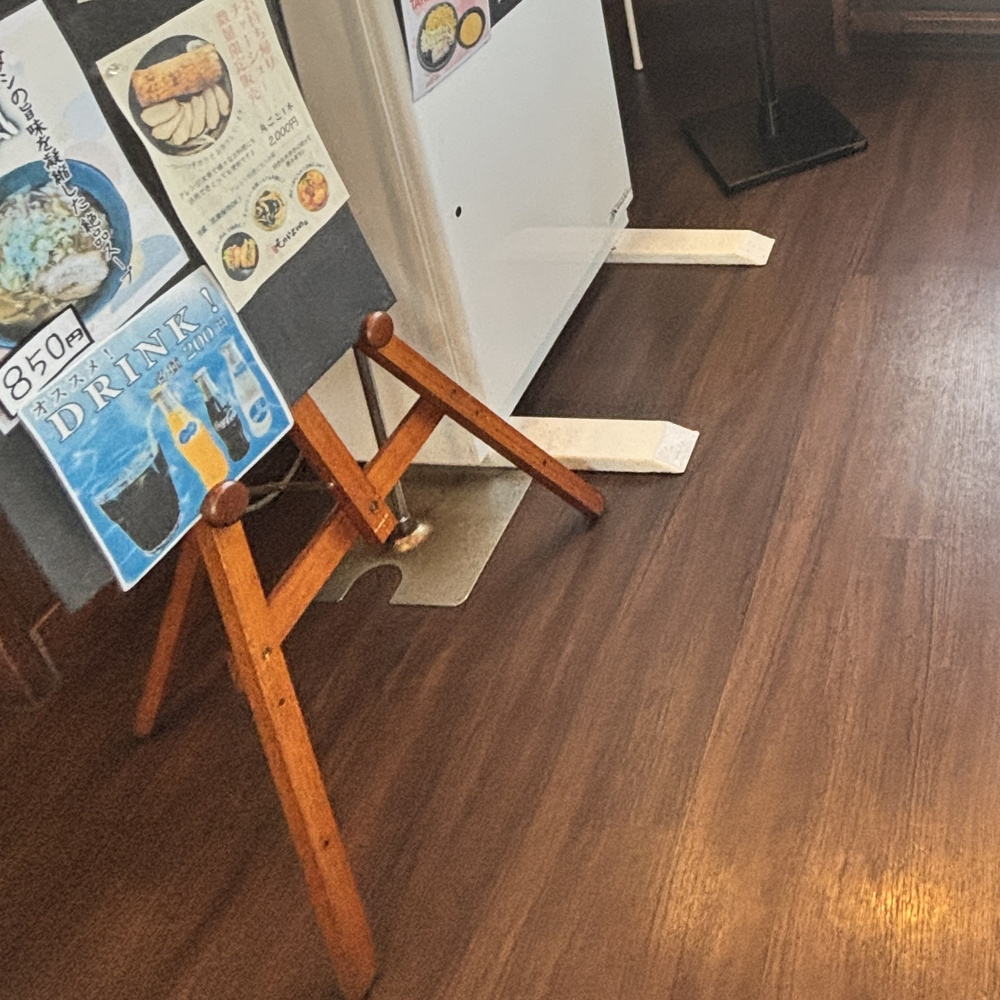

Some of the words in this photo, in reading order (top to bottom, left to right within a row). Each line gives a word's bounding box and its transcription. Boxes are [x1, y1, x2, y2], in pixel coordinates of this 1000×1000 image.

[0, 50, 132, 285] シの旨味を凝縮した絶品スープ
[3, 328, 84, 402] 850円
[182, 316, 229, 362] 200円
[33, 348, 115, 418] オススメ!
